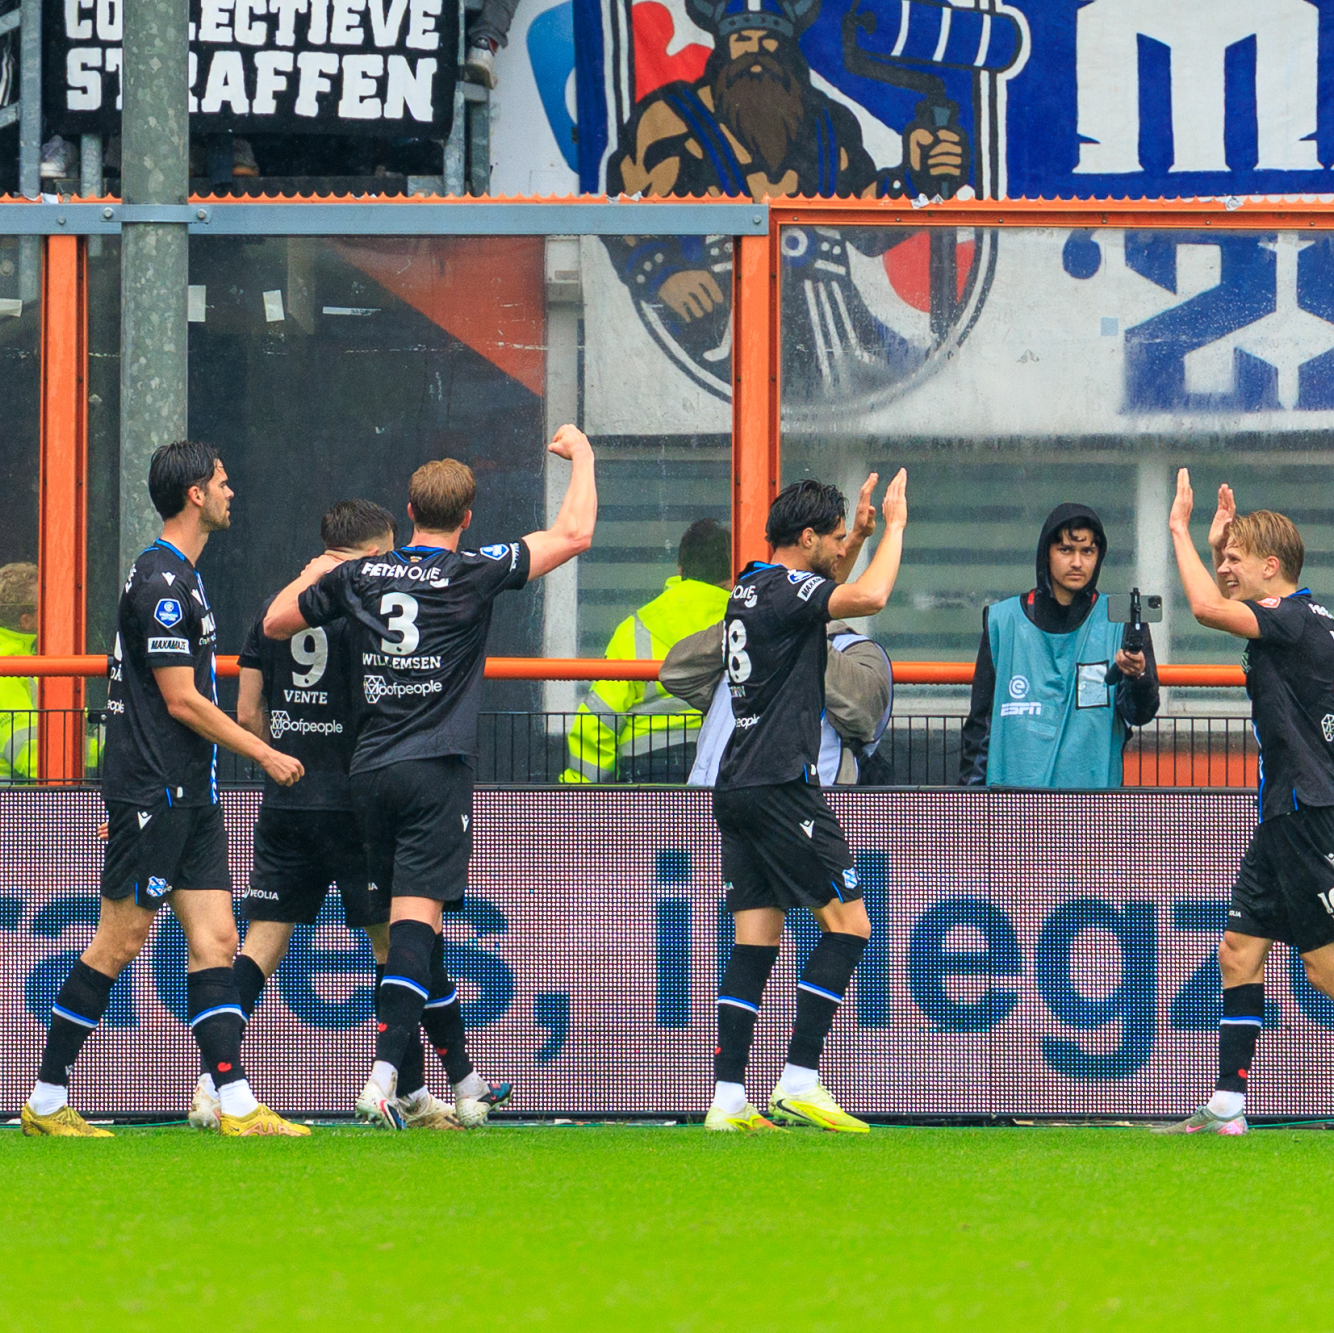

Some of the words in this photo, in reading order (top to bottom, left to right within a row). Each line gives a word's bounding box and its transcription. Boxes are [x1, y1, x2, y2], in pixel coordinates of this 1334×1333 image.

[380, 592, 420, 655] 3
[291, 626, 328, 687] 9
[362, 653, 442, 670] WILLEMSEN
[283, 689, 328, 705] VENTE
[1001, 702, 1042, 716] ESPN
